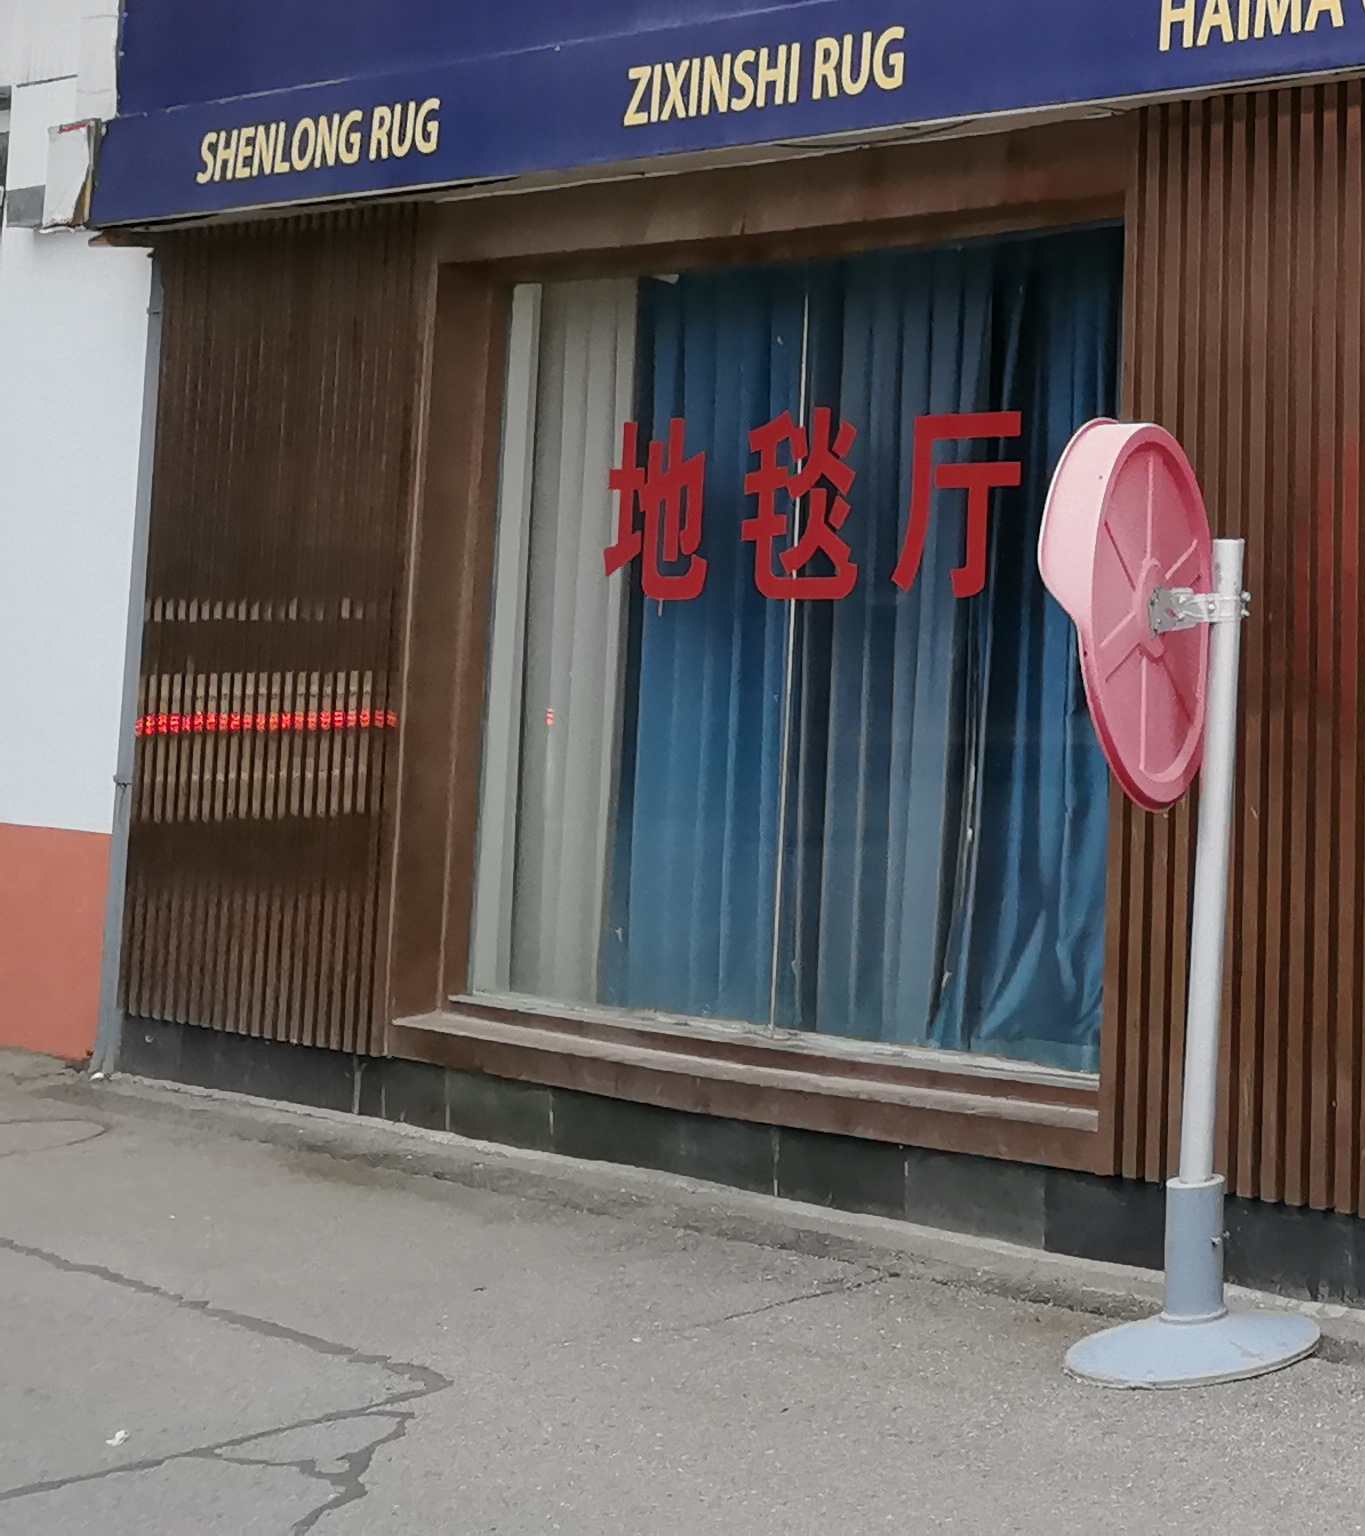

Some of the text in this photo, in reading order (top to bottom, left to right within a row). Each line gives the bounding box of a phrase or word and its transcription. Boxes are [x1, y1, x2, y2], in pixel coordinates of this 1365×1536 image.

[622, 25, 906, 127] ZIXINSHI RUG
[195, 97, 441, 184] SHENLONG RUG
[602, 406, 1022, 601] 地毯厅
